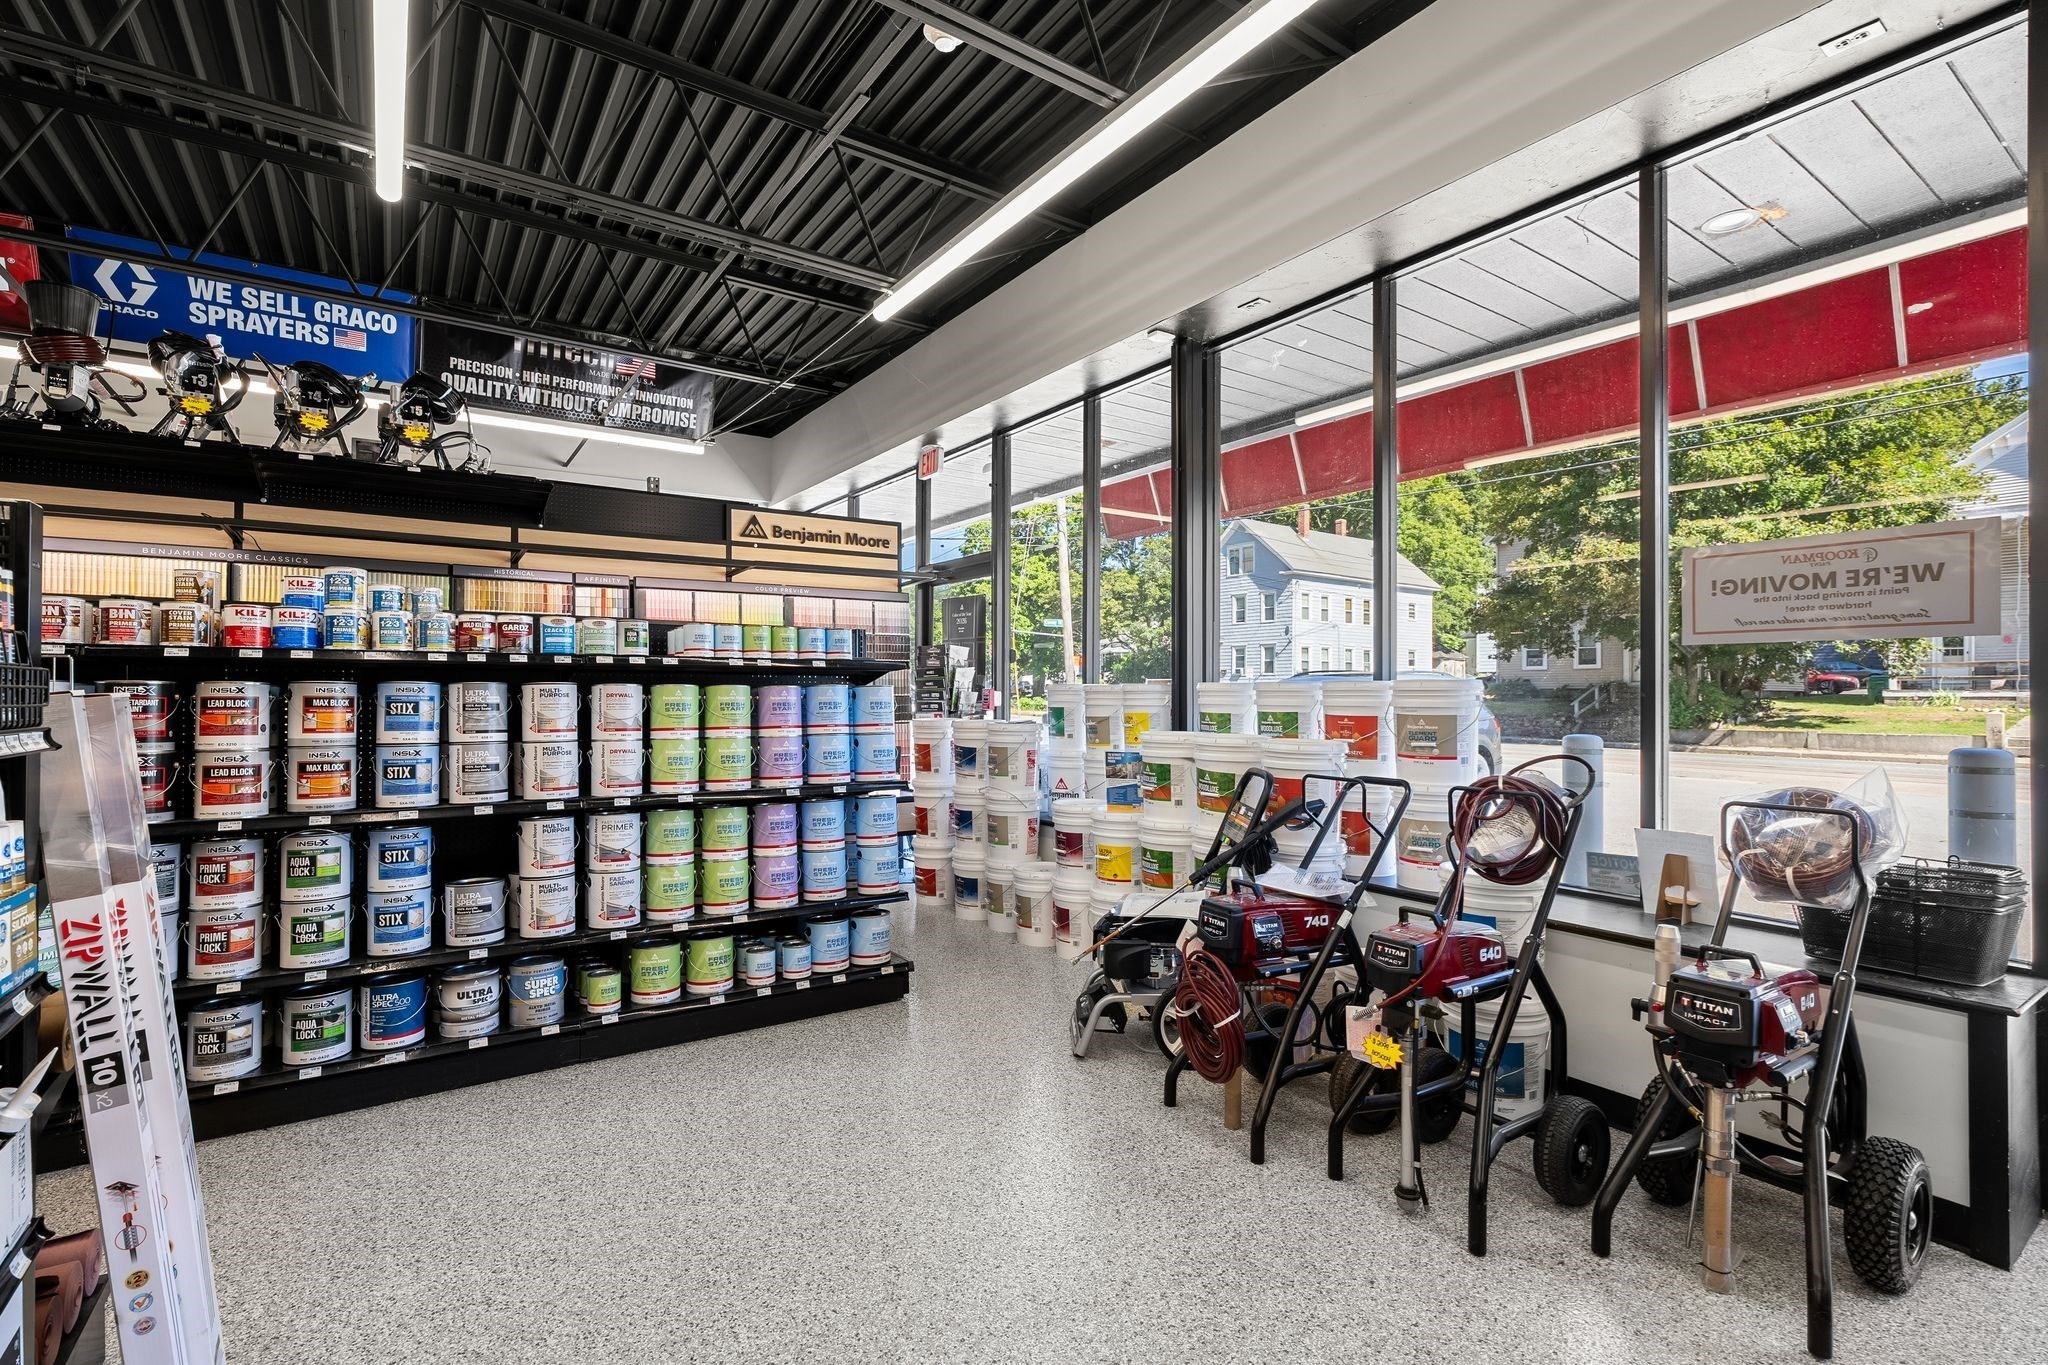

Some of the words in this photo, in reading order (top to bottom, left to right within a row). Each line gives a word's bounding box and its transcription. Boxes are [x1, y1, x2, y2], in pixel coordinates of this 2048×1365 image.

[187, 276, 232, 305] WE
[241, 287, 306, 318] SELL
[313, 301, 398, 334] GRACO
[99, 303, 159, 319] GRACO
[189, 303, 329, 345] SPRAYERS
[589, 369, 610, 379] MADE
[192, 373, 208, 387] T3
[449, 356, 513, 379] PRECISION
[522, 370, 550, 386] HIGH
[635, 389, 694, 410] INNOVATION
[308, 390, 322, 401] T4
[441, 372, 514, 400] QUALITY
[518, 385, 595, 413] WITHOUT
[598, 399, 697, 429] COMPROMISE
[410, 405, 423, 417] T5
[922, 449, 938, 477] EXIT
[772, 525, 842, 545] Benjamin
[846, 532, 890, 549] Moore
[142, 547, 203, 557] BENJAMIN
[209, 551, 250, 560] MOORE
[255, 555, 309, 564] CLASSICS
[494, 569, 534, 577] HISTORICAL
[235, 609, 267, 618] KILZ
[278, 611, 309, 619] KILZ
[390, 703, 414, 714] STIX
[231, 768, 254, 776] BLOCK
[387, 767, 412, 779] STIX
[602, 823, 634, 831] PRIMER
[1412, 840, 1441, 848] GUARD
[290, 857, 310, 867] AQUA
[385, 850, 409, 863] STIX
[200, 864, 226, 873] PRIME
[291, 867, 309, 876] LOCK
[200, 874, 221, 884] LOCK
[539, 886, 568, 894] PURPOSE
[379, 913, 403, 927] STIX
[1208, 918, 1225, 927] TITAN
[1304, 915, 1329, 928] 740
[296, 924, 317, 933] AQUA
[200, 932, 227, 943] PRIME
[296, 934, 317, 943] LOCK
[200, 943, 221, 953] LOCK
[1384, 948, 1406, 958] TITAN
[1479, 946, 1501, 962] 640
[1377, 956, 1402, 965] IMPACT
[60, 913, 118, 1054] ZIPWALL
[526, 977, 558, 990] SUPER
[372, 993, 398, 1001] ULTRA
[457, 986, 493, 1001] ULTRA
[530, 988, 556, 999] SPEC
[372, 1000, 393, 1008] SPEC
[394, 997, 411, 1008] 500
[472, 997, 490, 1005] SPEC
[1801, 993, 1815, 1011] 840
[1694, 1001, 1734, 1016] TITAN
[296, 1019, 317, 1030] AQUA
[1684, 1012, 1729, 1027] IMPACT
[198, 1033, 219, 1044] SEAL
[296, 1029, 317, 1040] LOCK
[198, 1043, 220, 1055] LOCK
[91, 1056, 118, 1086] 10
[95, 1093, 113, 1109] x2
